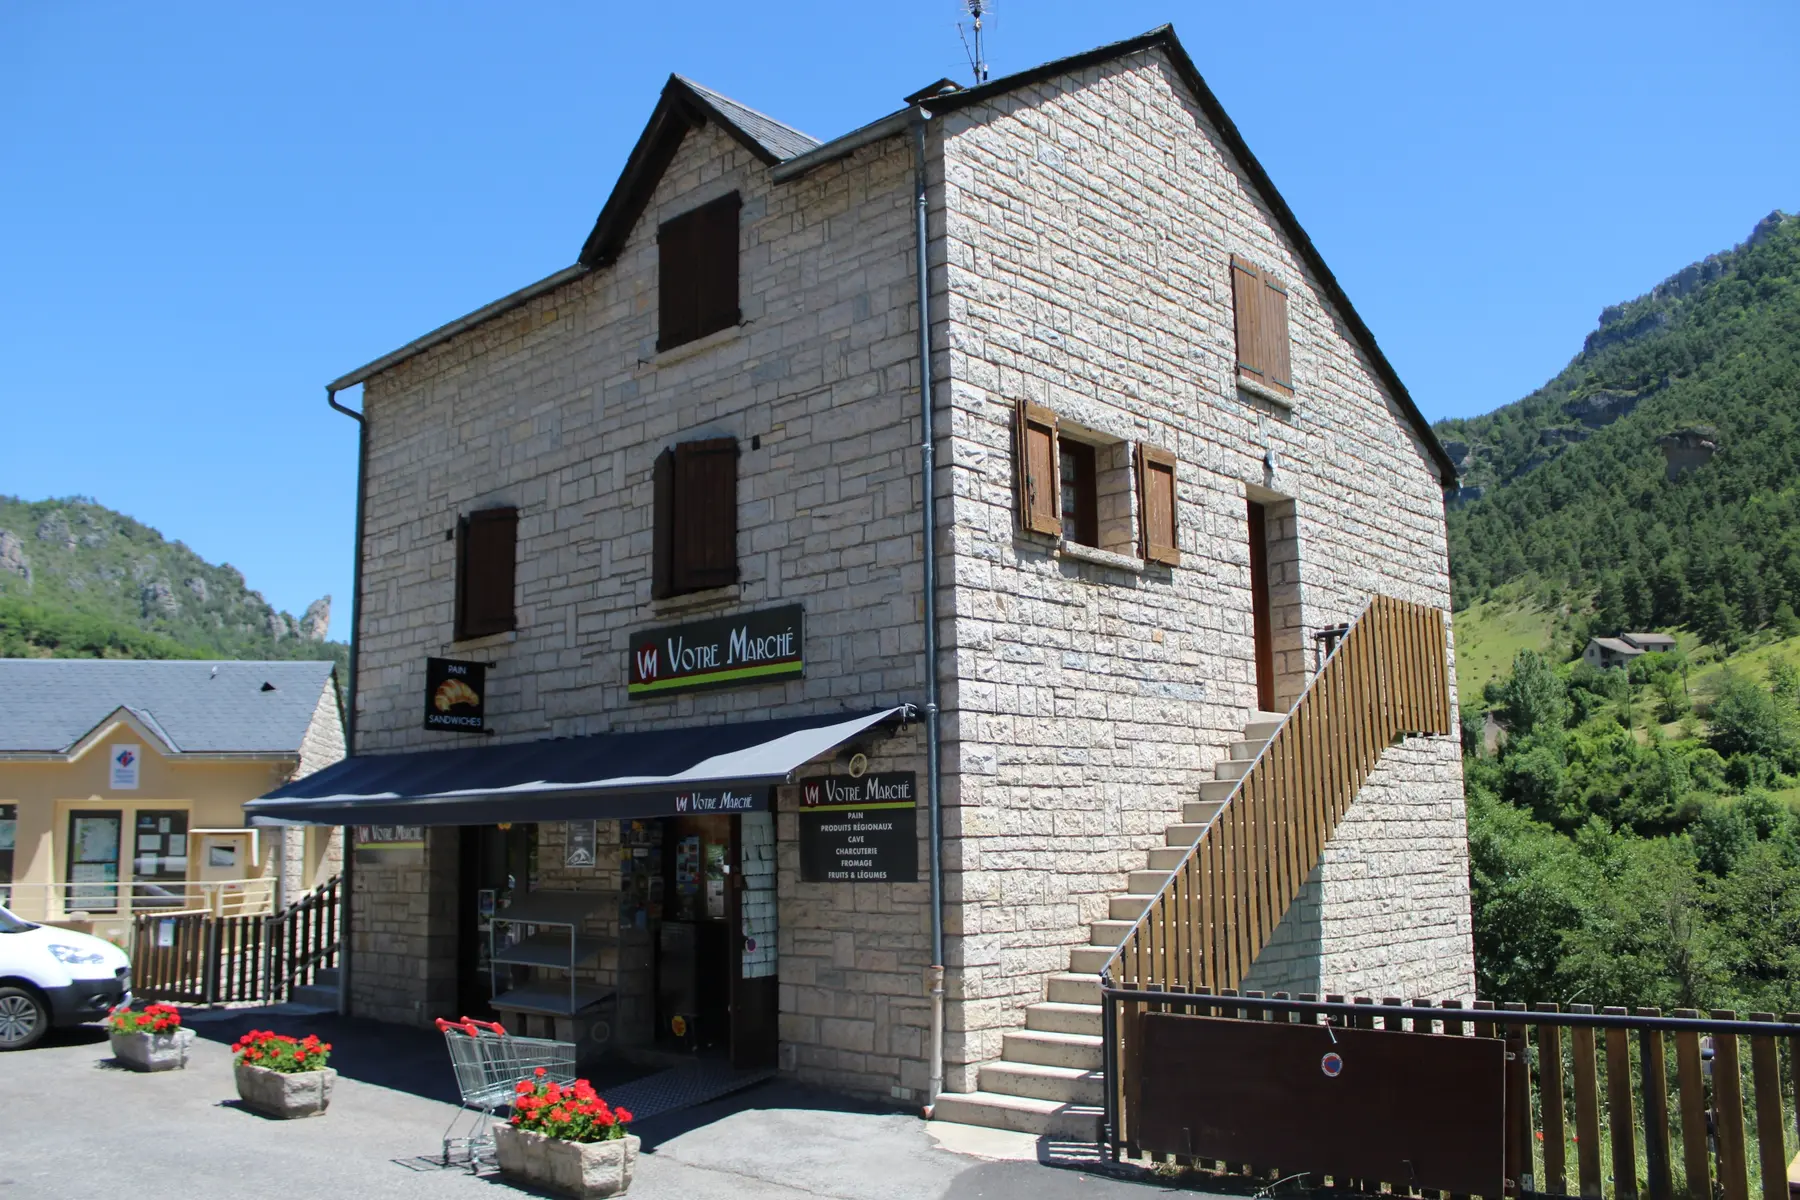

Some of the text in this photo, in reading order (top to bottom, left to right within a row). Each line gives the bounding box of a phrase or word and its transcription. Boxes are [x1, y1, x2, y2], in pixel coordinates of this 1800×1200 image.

[667, 636, 721, 672] VOTRE
[726, 625, 797, 665] MARCHÉ
[448, 665, 467, 674] PAIN
[428, 714, 482, 726] SANDWICHES
[825, 779, 862, 802] VOTRE
[865, 777, 912, 800] MARCHÉ
[692, 792, 717, 810] VOTRE
[719, 791, 753, 809] MARCHÉ
[820, 821, 893, 832] PRODUITS RÉGIONAUX
[835, 847, 878, 855] CHARCUTERIE
[828, 869, 887, 879] FRUITS & LÉGUMES
